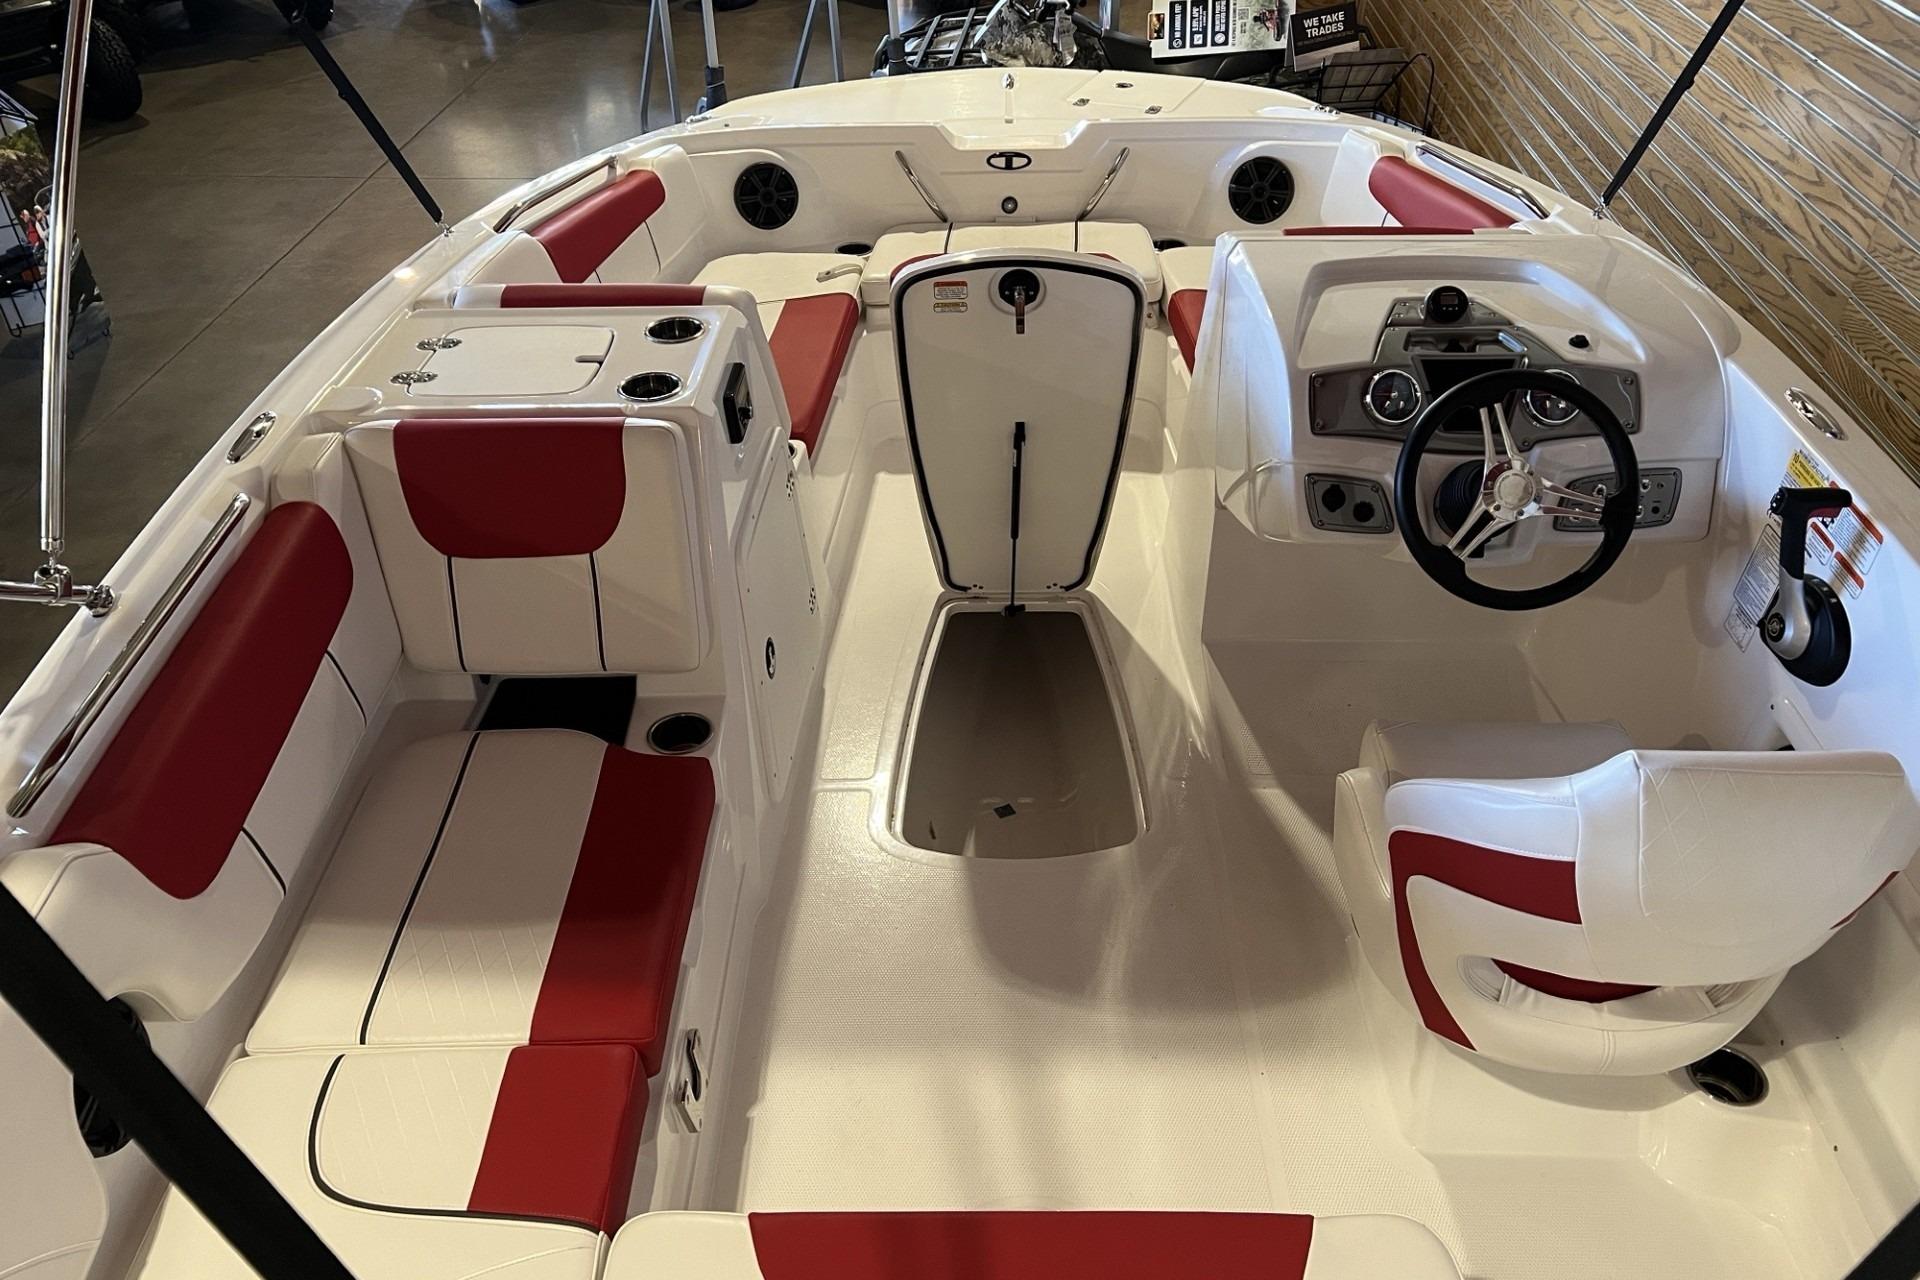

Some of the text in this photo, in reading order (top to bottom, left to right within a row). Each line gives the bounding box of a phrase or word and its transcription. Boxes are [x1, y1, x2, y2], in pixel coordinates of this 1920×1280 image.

[1303, 11, 1345, 28] WE TAKE
[1305, 22, 1344, 38] TRADES
